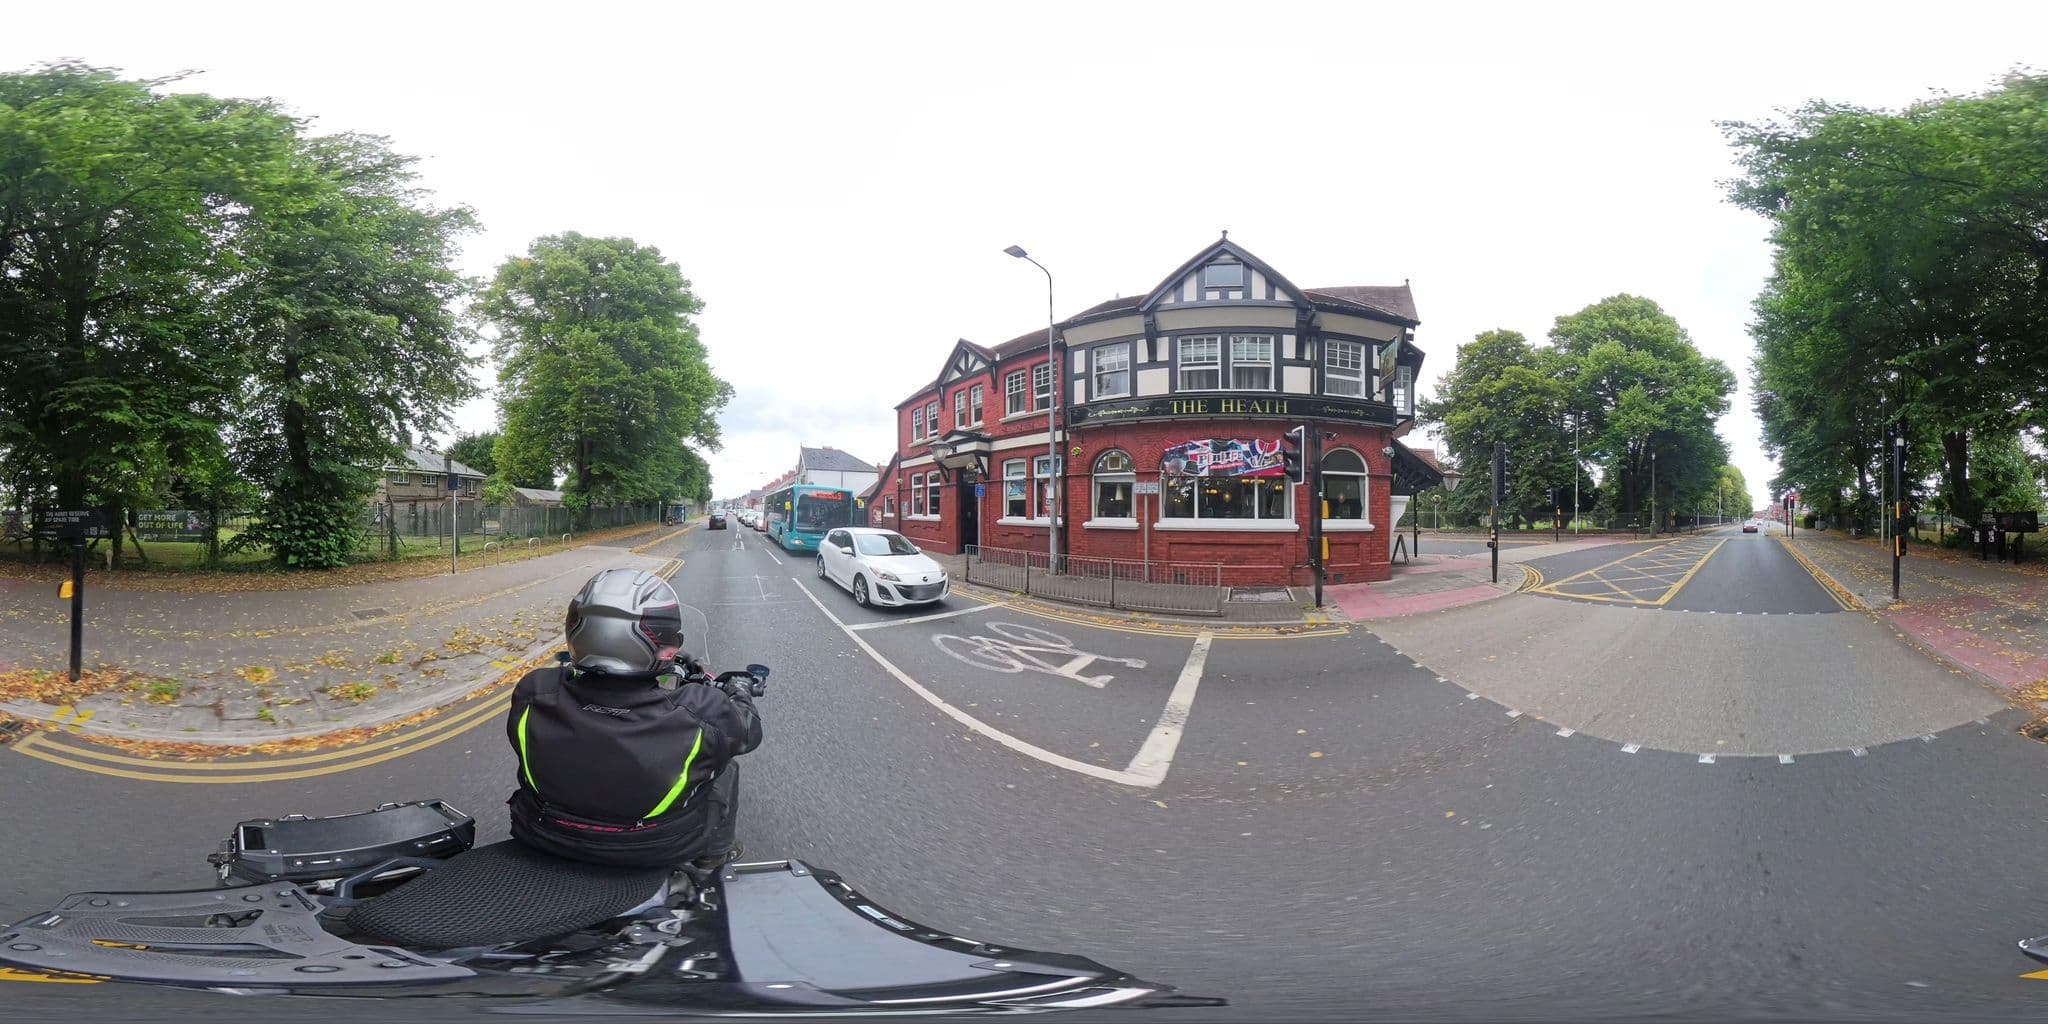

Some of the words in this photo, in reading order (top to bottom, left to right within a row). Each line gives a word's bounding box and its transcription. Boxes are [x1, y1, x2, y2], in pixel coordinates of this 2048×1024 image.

[1169, 399, 1208, 414] THE
[1221, 399, 1288, 414] HEATH
[167, 521, 184, 529] LIFE
